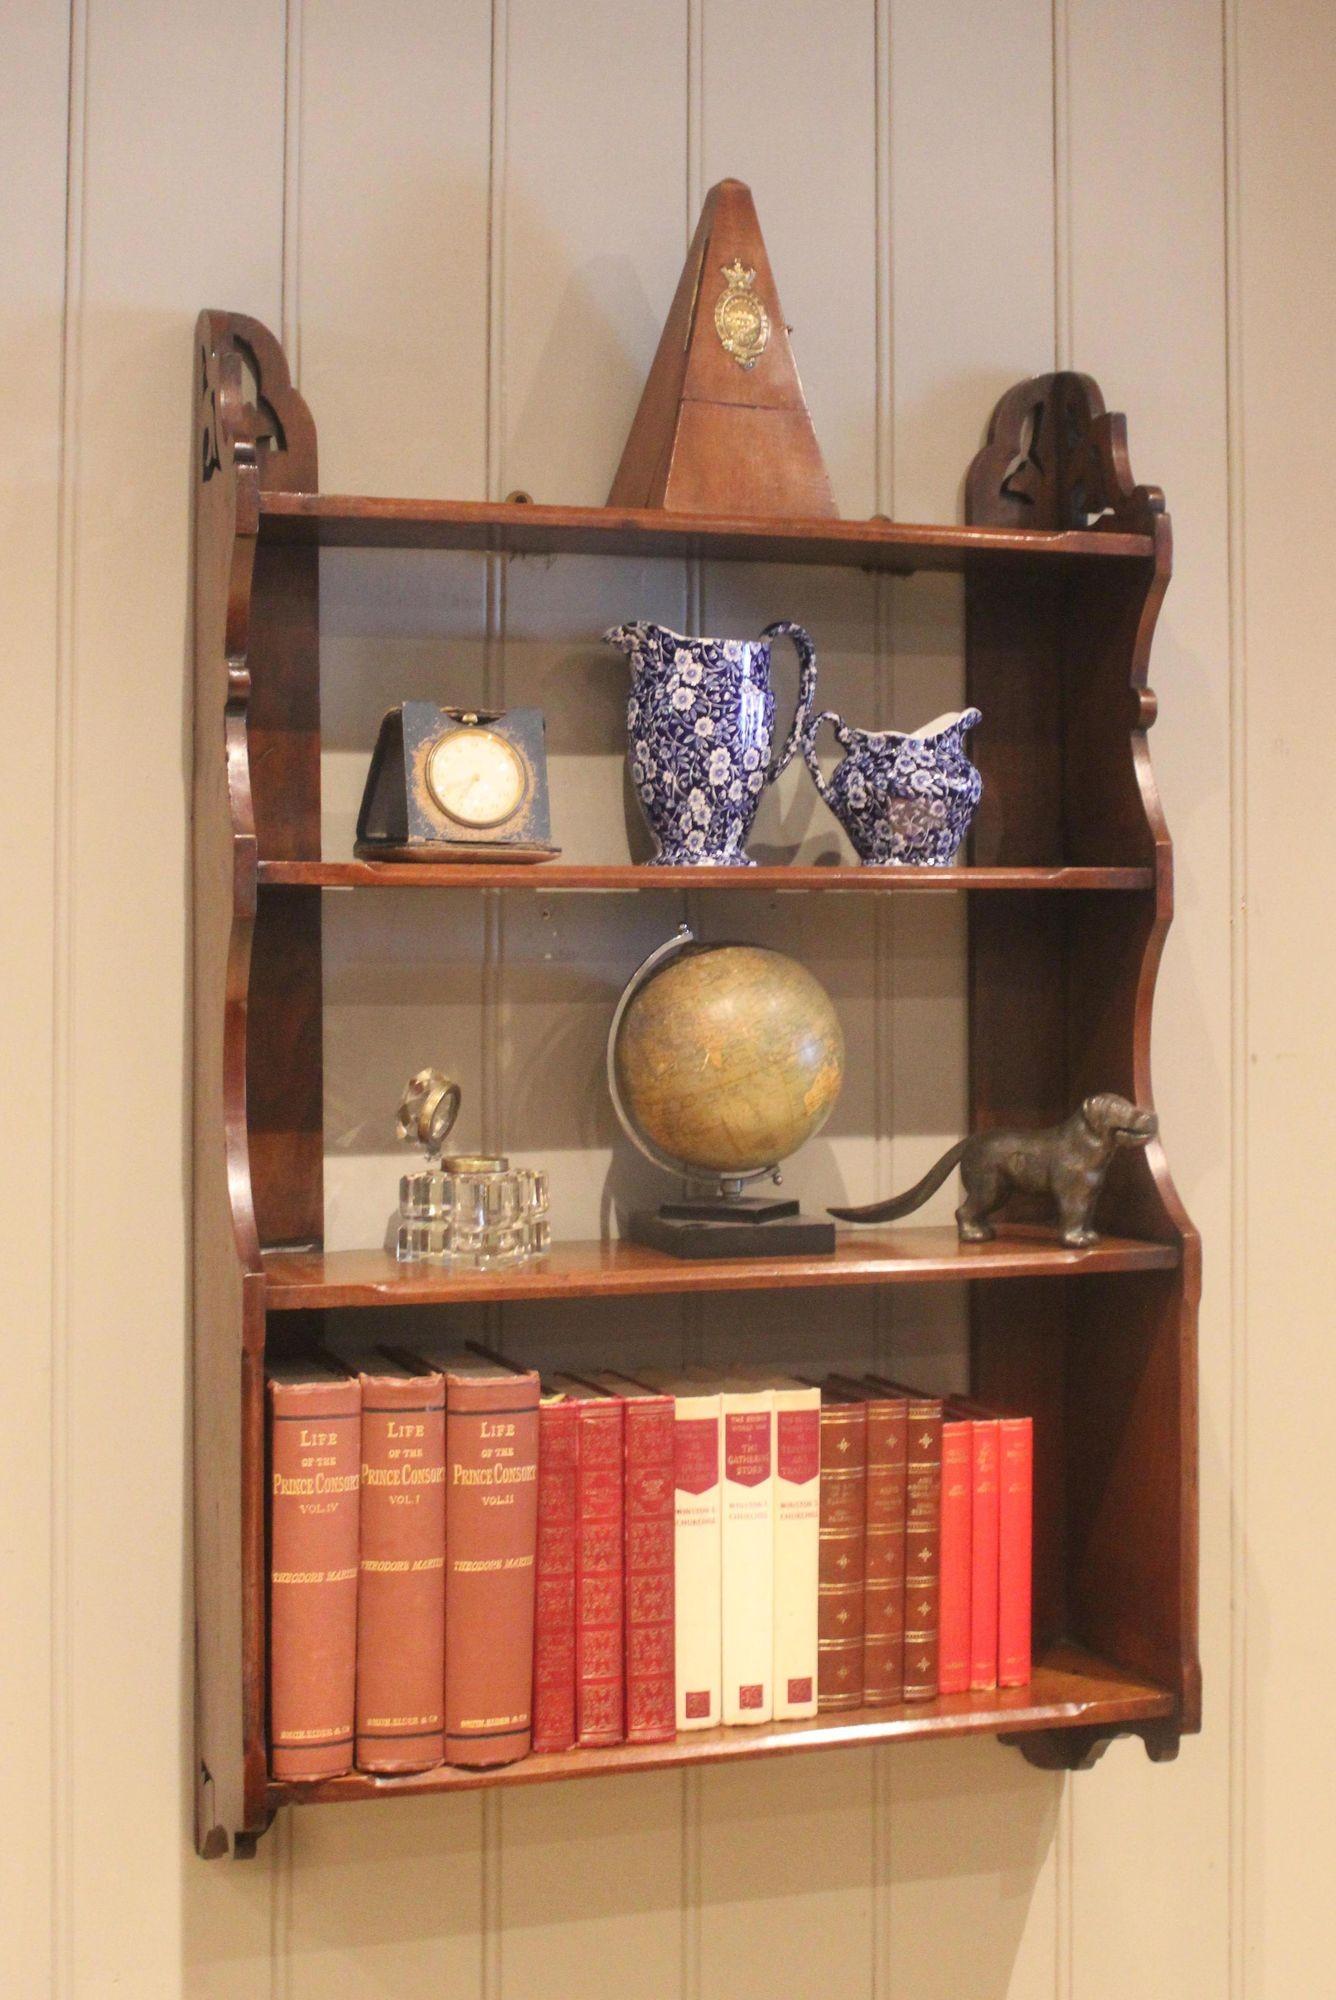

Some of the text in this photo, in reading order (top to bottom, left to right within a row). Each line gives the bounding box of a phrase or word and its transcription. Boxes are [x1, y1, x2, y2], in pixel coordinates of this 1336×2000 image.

[300, 1429, 338, 1447] LIFE
[386, 1421, 425, 1439] LIFE
[479, 1421, 516, 1439] LIFE
[388, 1448, 423, 1459] OF THE
[480, 1447, 514, 1458] OF THE
[301, 1456, 337, 1468] OF THE
[361, 1463, 400, 1486] PRINCE
[452, 1463, 493, 1486] PRINCE
[273, 1473, 314, 1495] PRINCE
